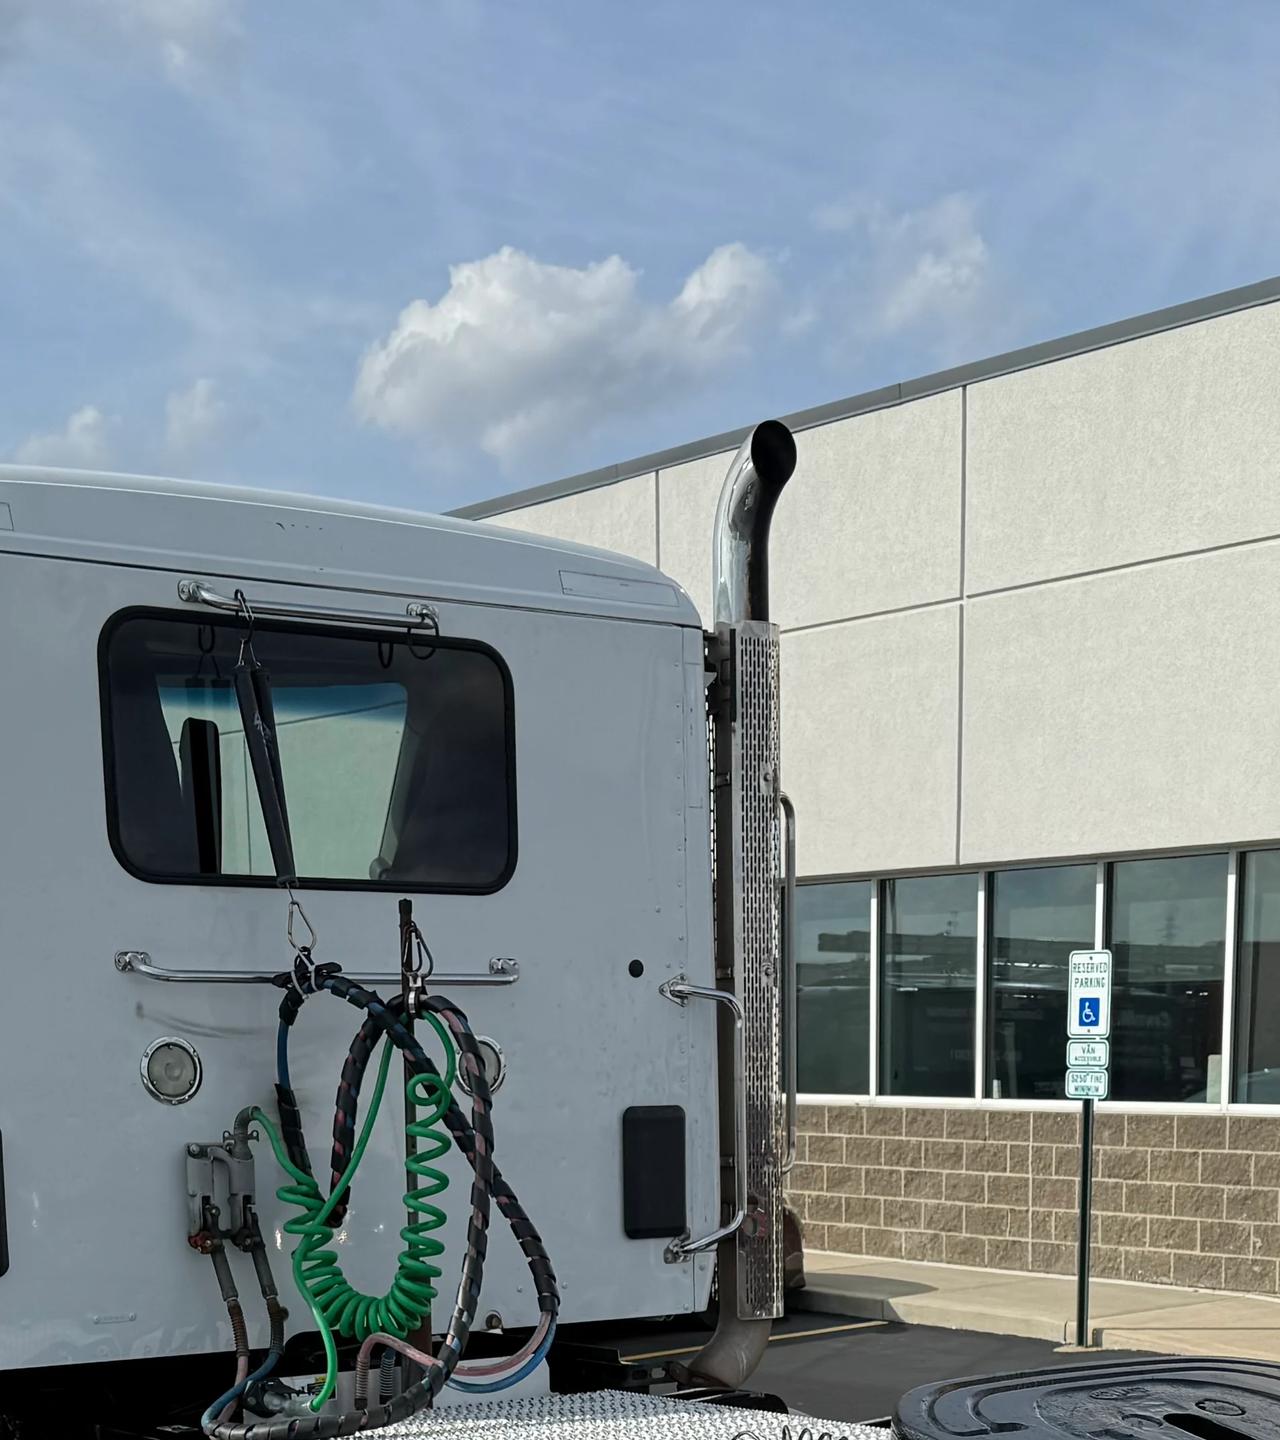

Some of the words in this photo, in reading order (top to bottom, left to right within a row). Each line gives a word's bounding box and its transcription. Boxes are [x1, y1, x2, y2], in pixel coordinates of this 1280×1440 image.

[1073, 962, 1108, 973] RESERVED
[1074, 977, 1106, 989] PARKING
[1081, 1046, 1096, 1055] VAN
[1071, 1073, 1087, 1084] $250
[1089, 1073, 1103, 1084] FINE
